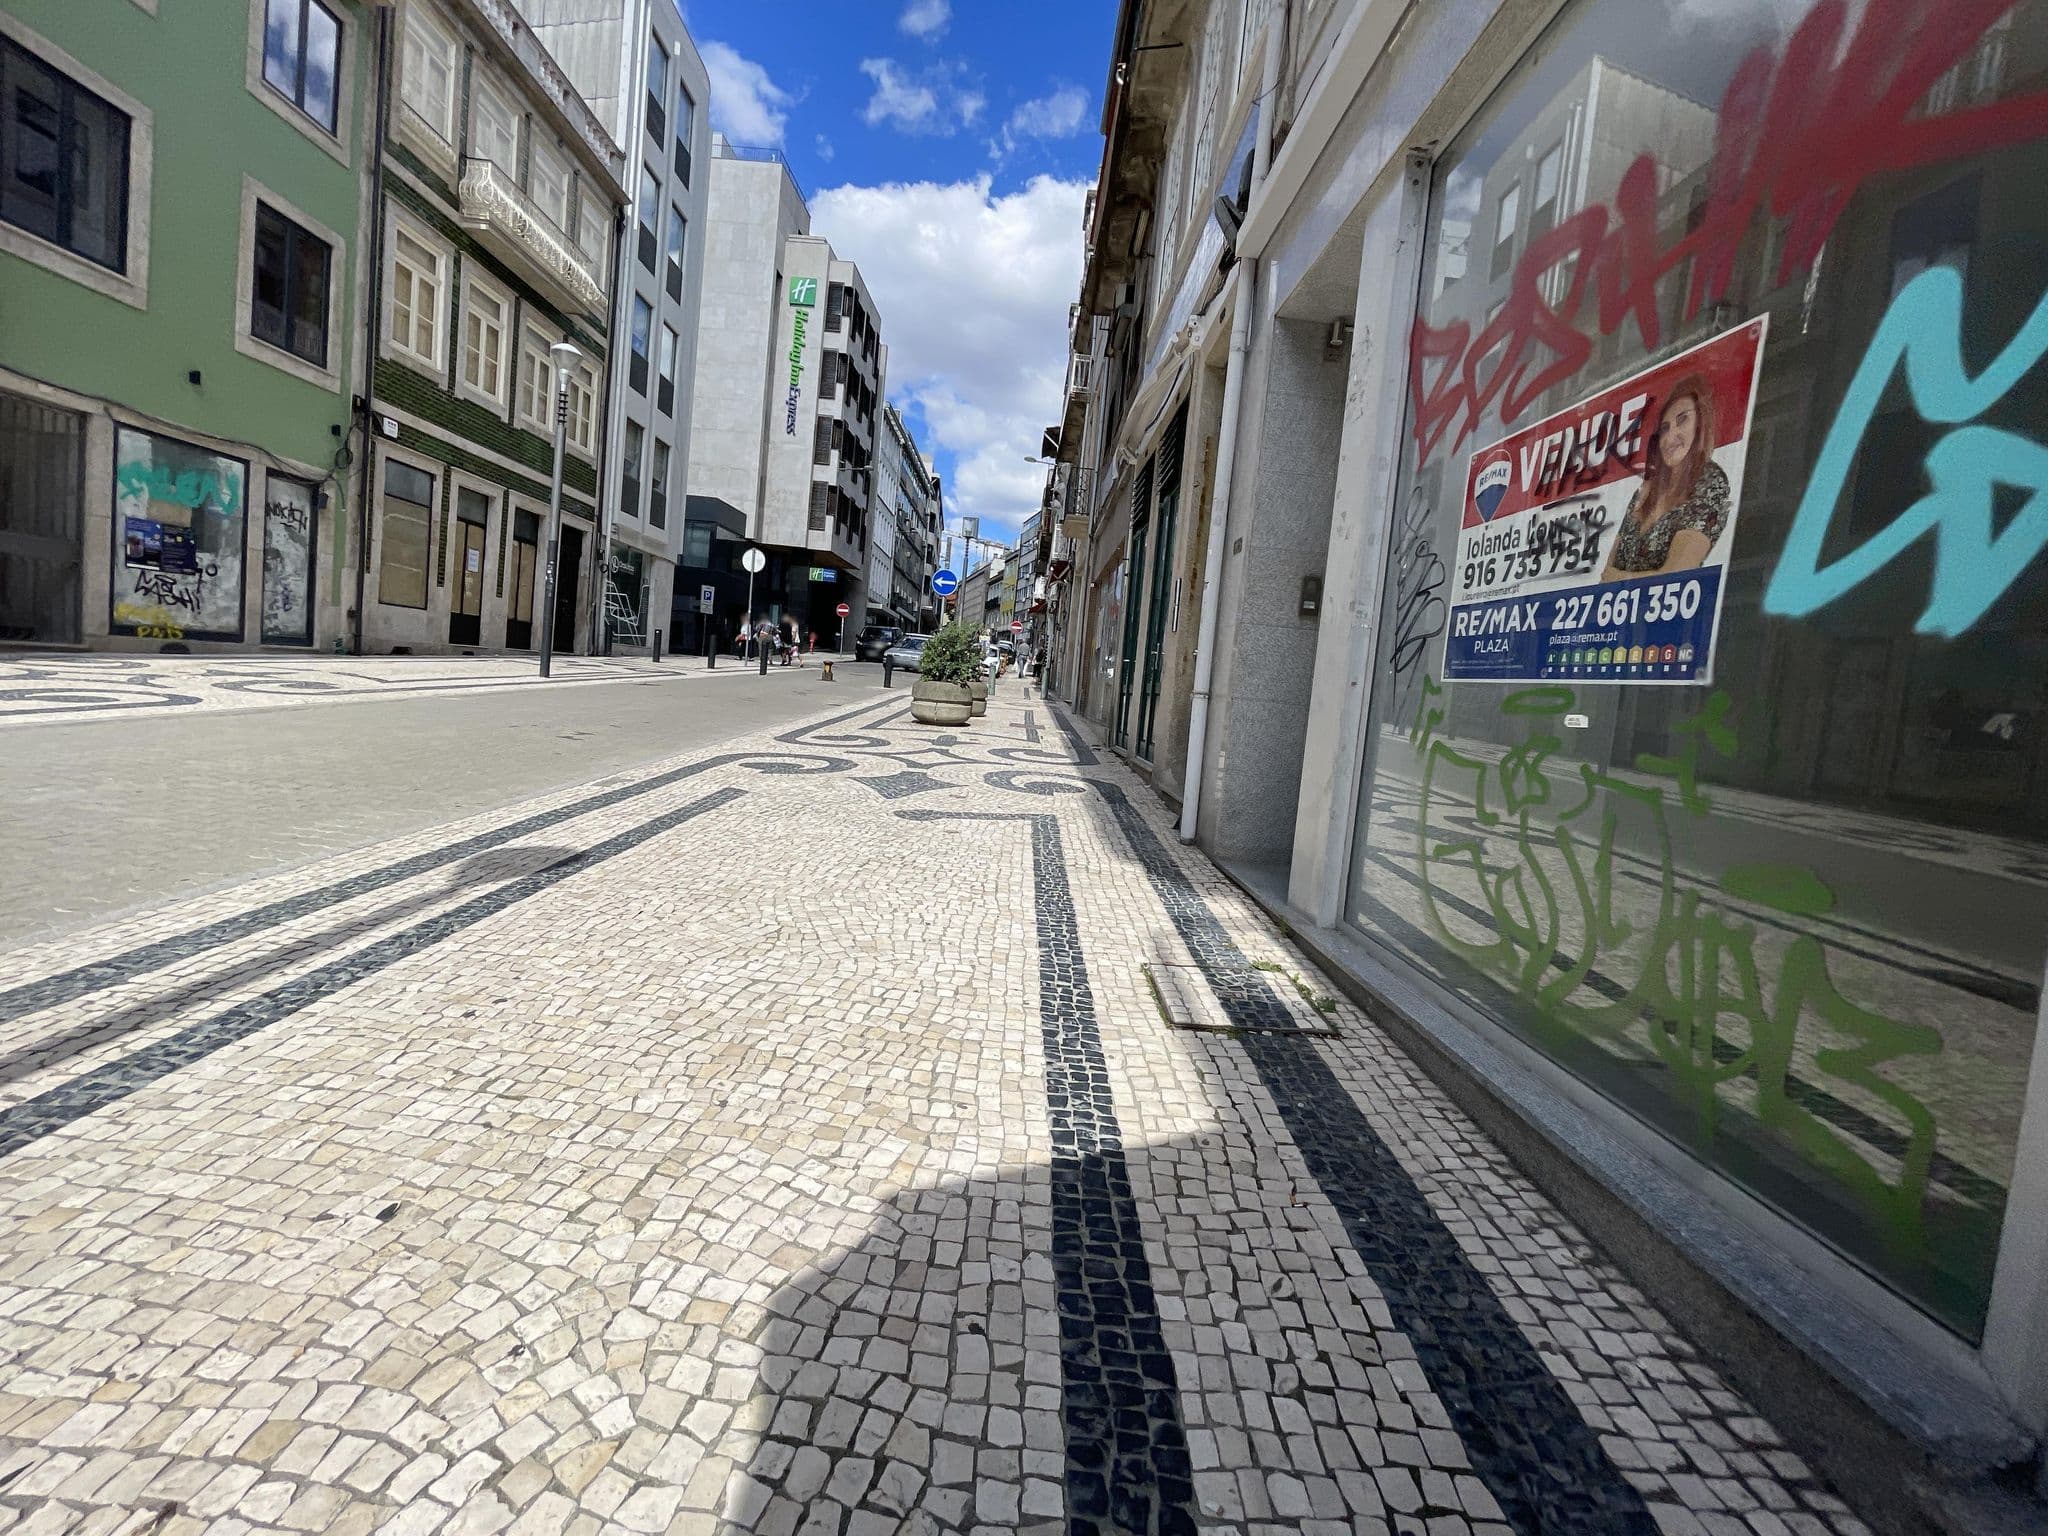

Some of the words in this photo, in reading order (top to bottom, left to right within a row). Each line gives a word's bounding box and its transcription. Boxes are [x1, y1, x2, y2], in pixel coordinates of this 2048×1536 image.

[789, 308, 809, 362] Holiday
[785, 384, 801, 437] Express
[1520, 393, 1648, 493] VENDE
[1479, 467, 1508, 488] RE/MAX
[1466, 524, 1522, 560] Iolanda
[1526, 503, 1607, 545] Loueiro
[1463, 557, 1496, 589] 916
[1501, 548, 1542, 582] 733
[1549, 530, 1602, 573] 754
[1454, 602, 1540, 637] RE/MAX
[1551, 594, 1595, 630] 227
[1597, 588, 1641, 627] 661
[1644, 579, 1701, 623] 350
[1474, 639, 1509, 654] PLAZA
[1549, 630, 1618, 647] plaza@remax.pt
[1664, 649, 1672, 660] G
[1678, 648, 1692, 660] NC
